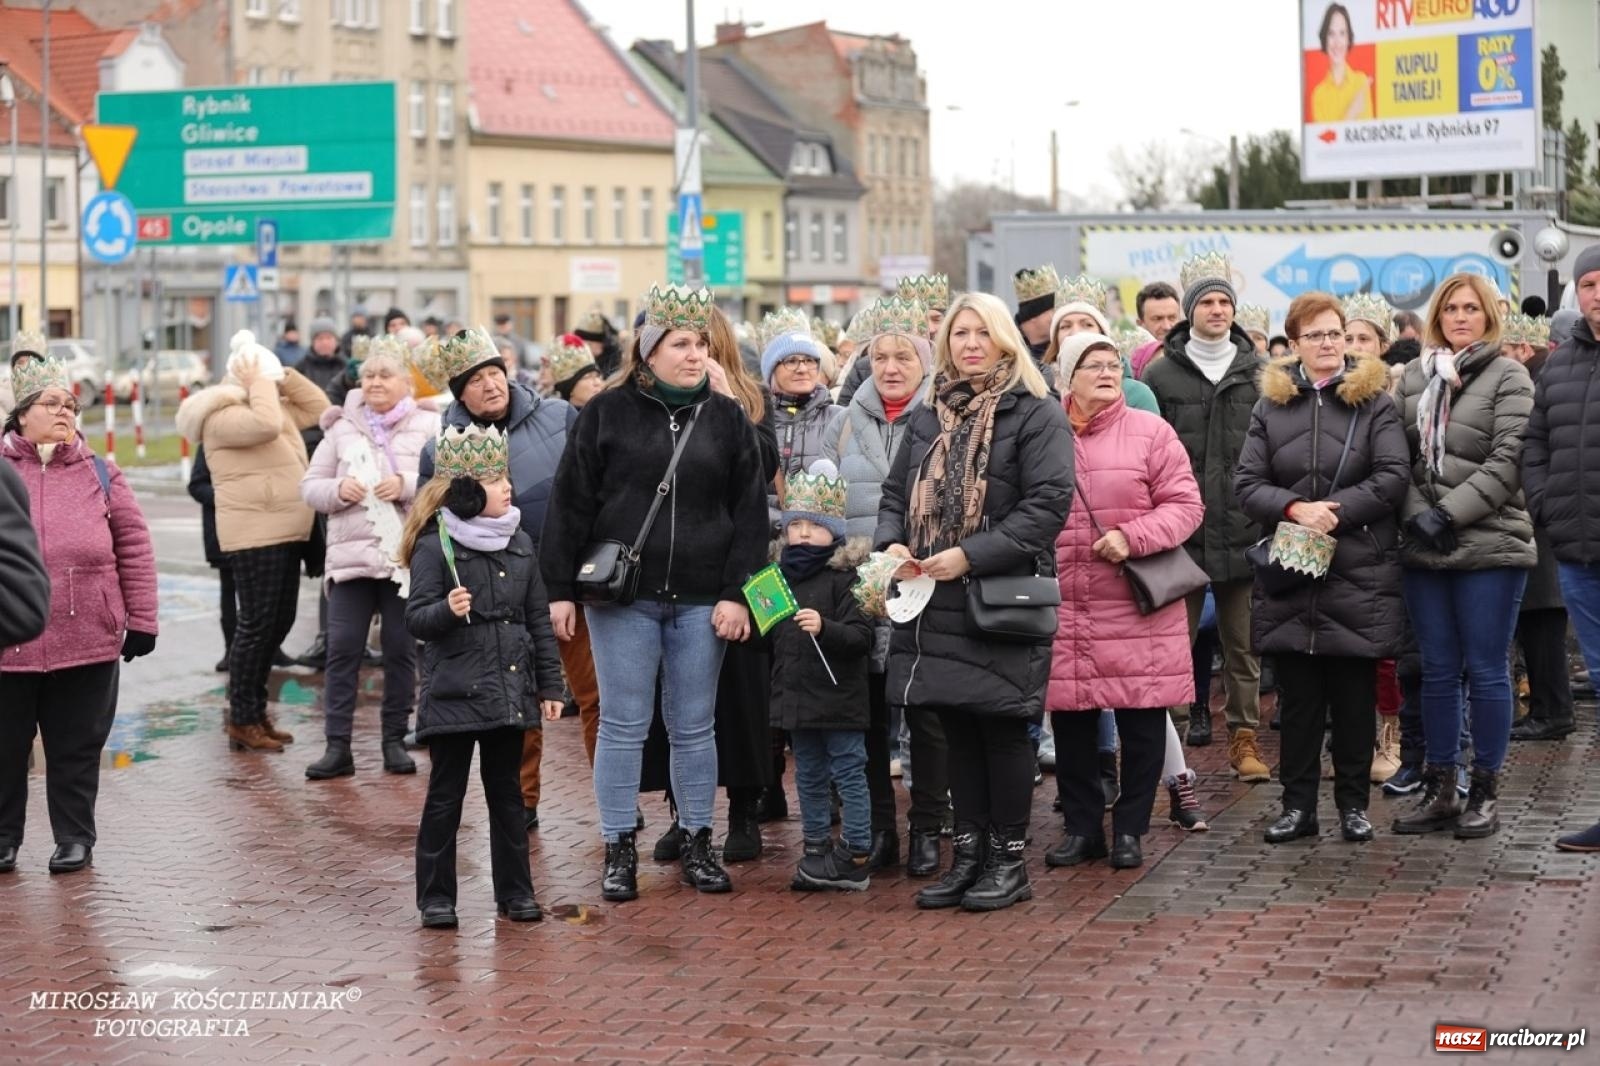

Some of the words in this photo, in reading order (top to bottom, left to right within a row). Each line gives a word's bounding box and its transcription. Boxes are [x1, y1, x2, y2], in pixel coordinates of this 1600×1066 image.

[1416, 0, 1470, 17] EURO
[1477, 34, 1515, 57] RATY
[1395, 53, 1438, 76] KUPUJ
[1392, 80, 1441, 103] TANIEJ!
[182, 95, 251, 119] Rybnik
[181, 123, 259, 144] Gliwice
[1427, 119, 1481, 143] Rybnicka
[1484, 118, 1500, 135] 97
[191, 182, 270, 198] Starostwo
[280, 178, 365, 195] Powiatowe
[142, 219, 165, 236] 45
[183, 216, 247, 240] Opole
